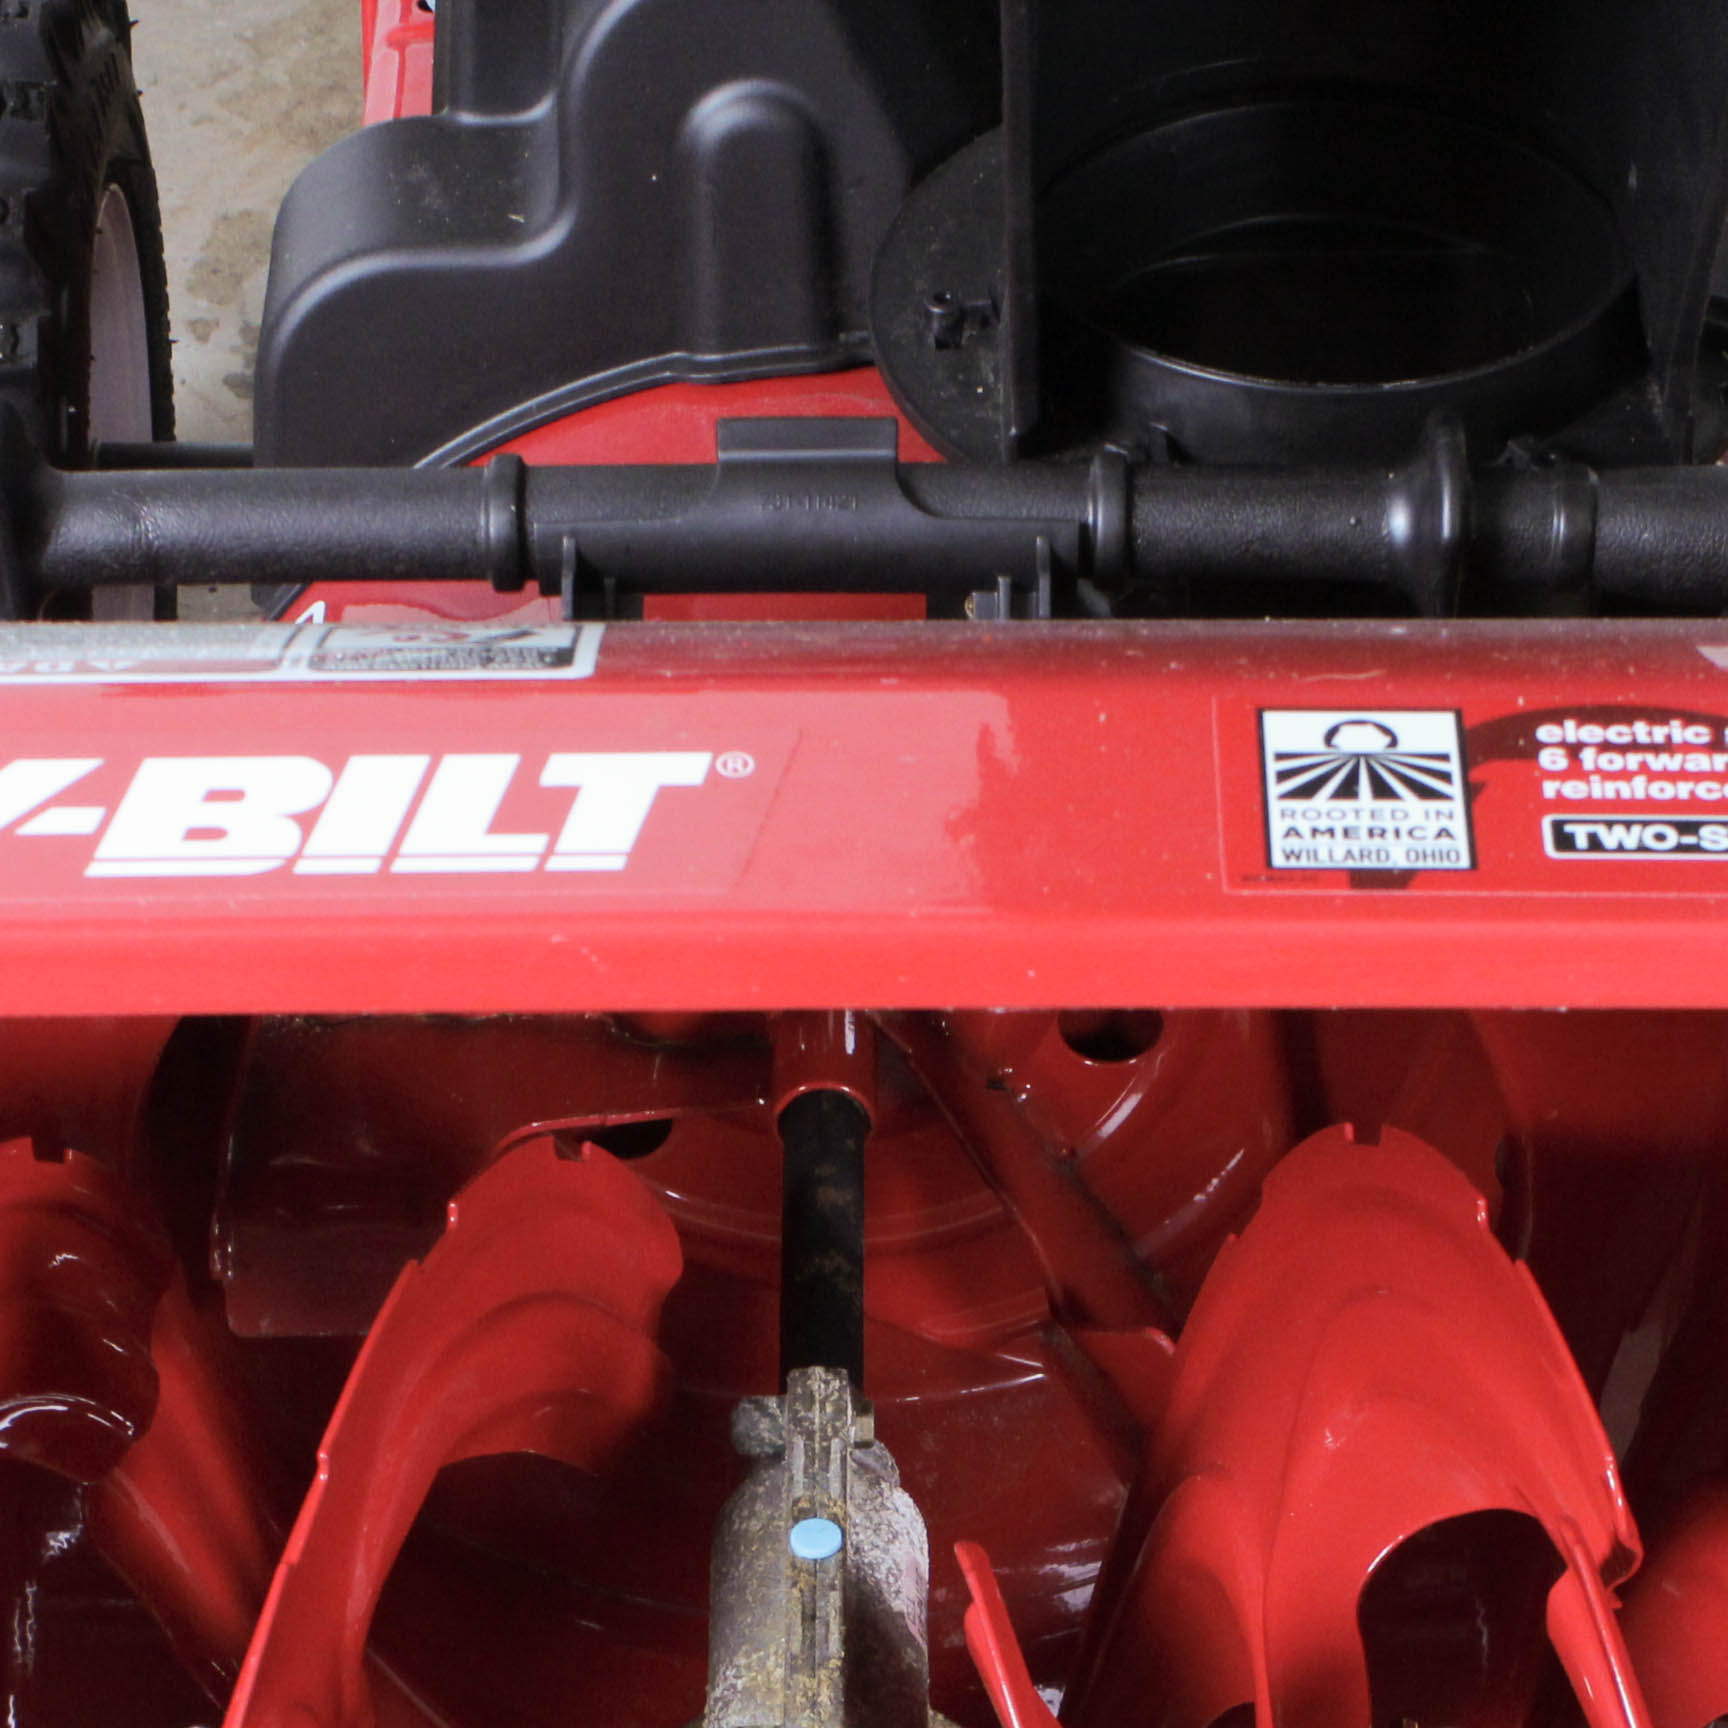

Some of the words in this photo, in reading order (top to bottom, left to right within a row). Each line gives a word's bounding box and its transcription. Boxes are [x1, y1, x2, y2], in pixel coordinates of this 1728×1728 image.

[1535, 720, 1711, 745] electric
[1538, 747, 1569, 772] 6
[1280, 808, 1409, 821] ROOTED
[1424, 808, 1454, 821] IN
[1282, 826, 1456, 841] AMERICA
[1282, 848, 1398, 865] WILLARD,
[1405, 849, 1461, 865] OHIO
